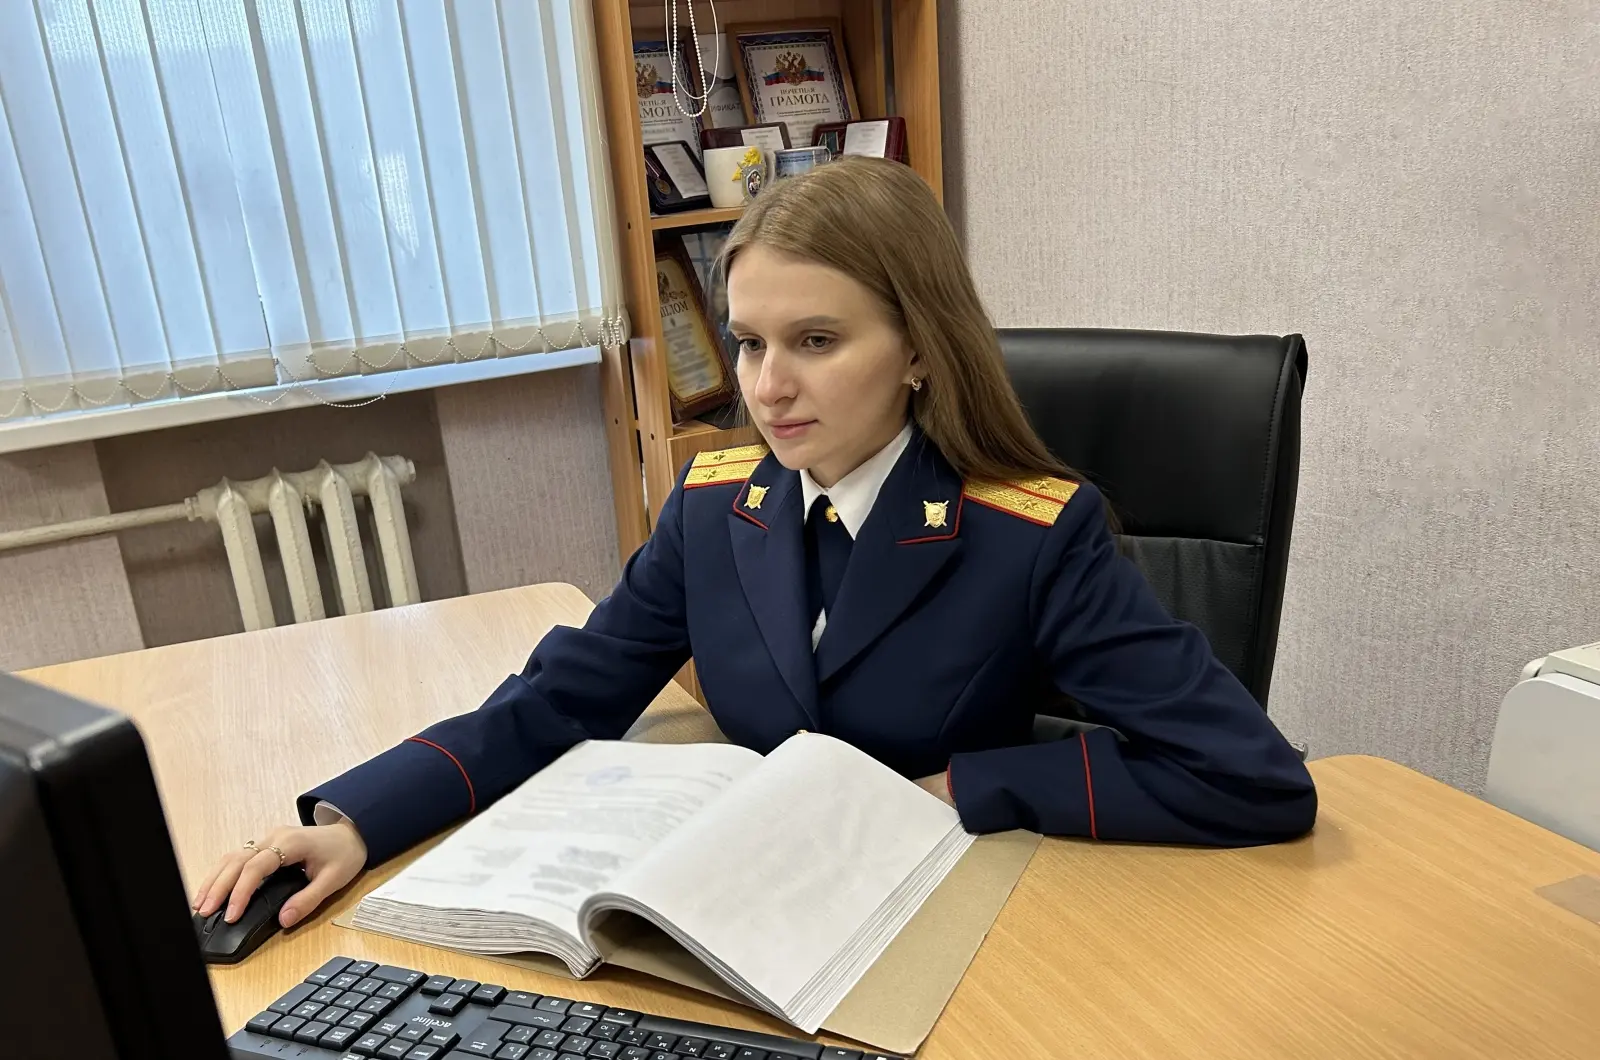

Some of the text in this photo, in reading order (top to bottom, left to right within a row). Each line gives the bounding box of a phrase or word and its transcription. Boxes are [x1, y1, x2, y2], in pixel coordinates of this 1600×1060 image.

[770, 94, 830, 107] ГРАМОТА
[640, 105, 681, 118] МОТА
[411, 1016, 452, 1028] aceline
